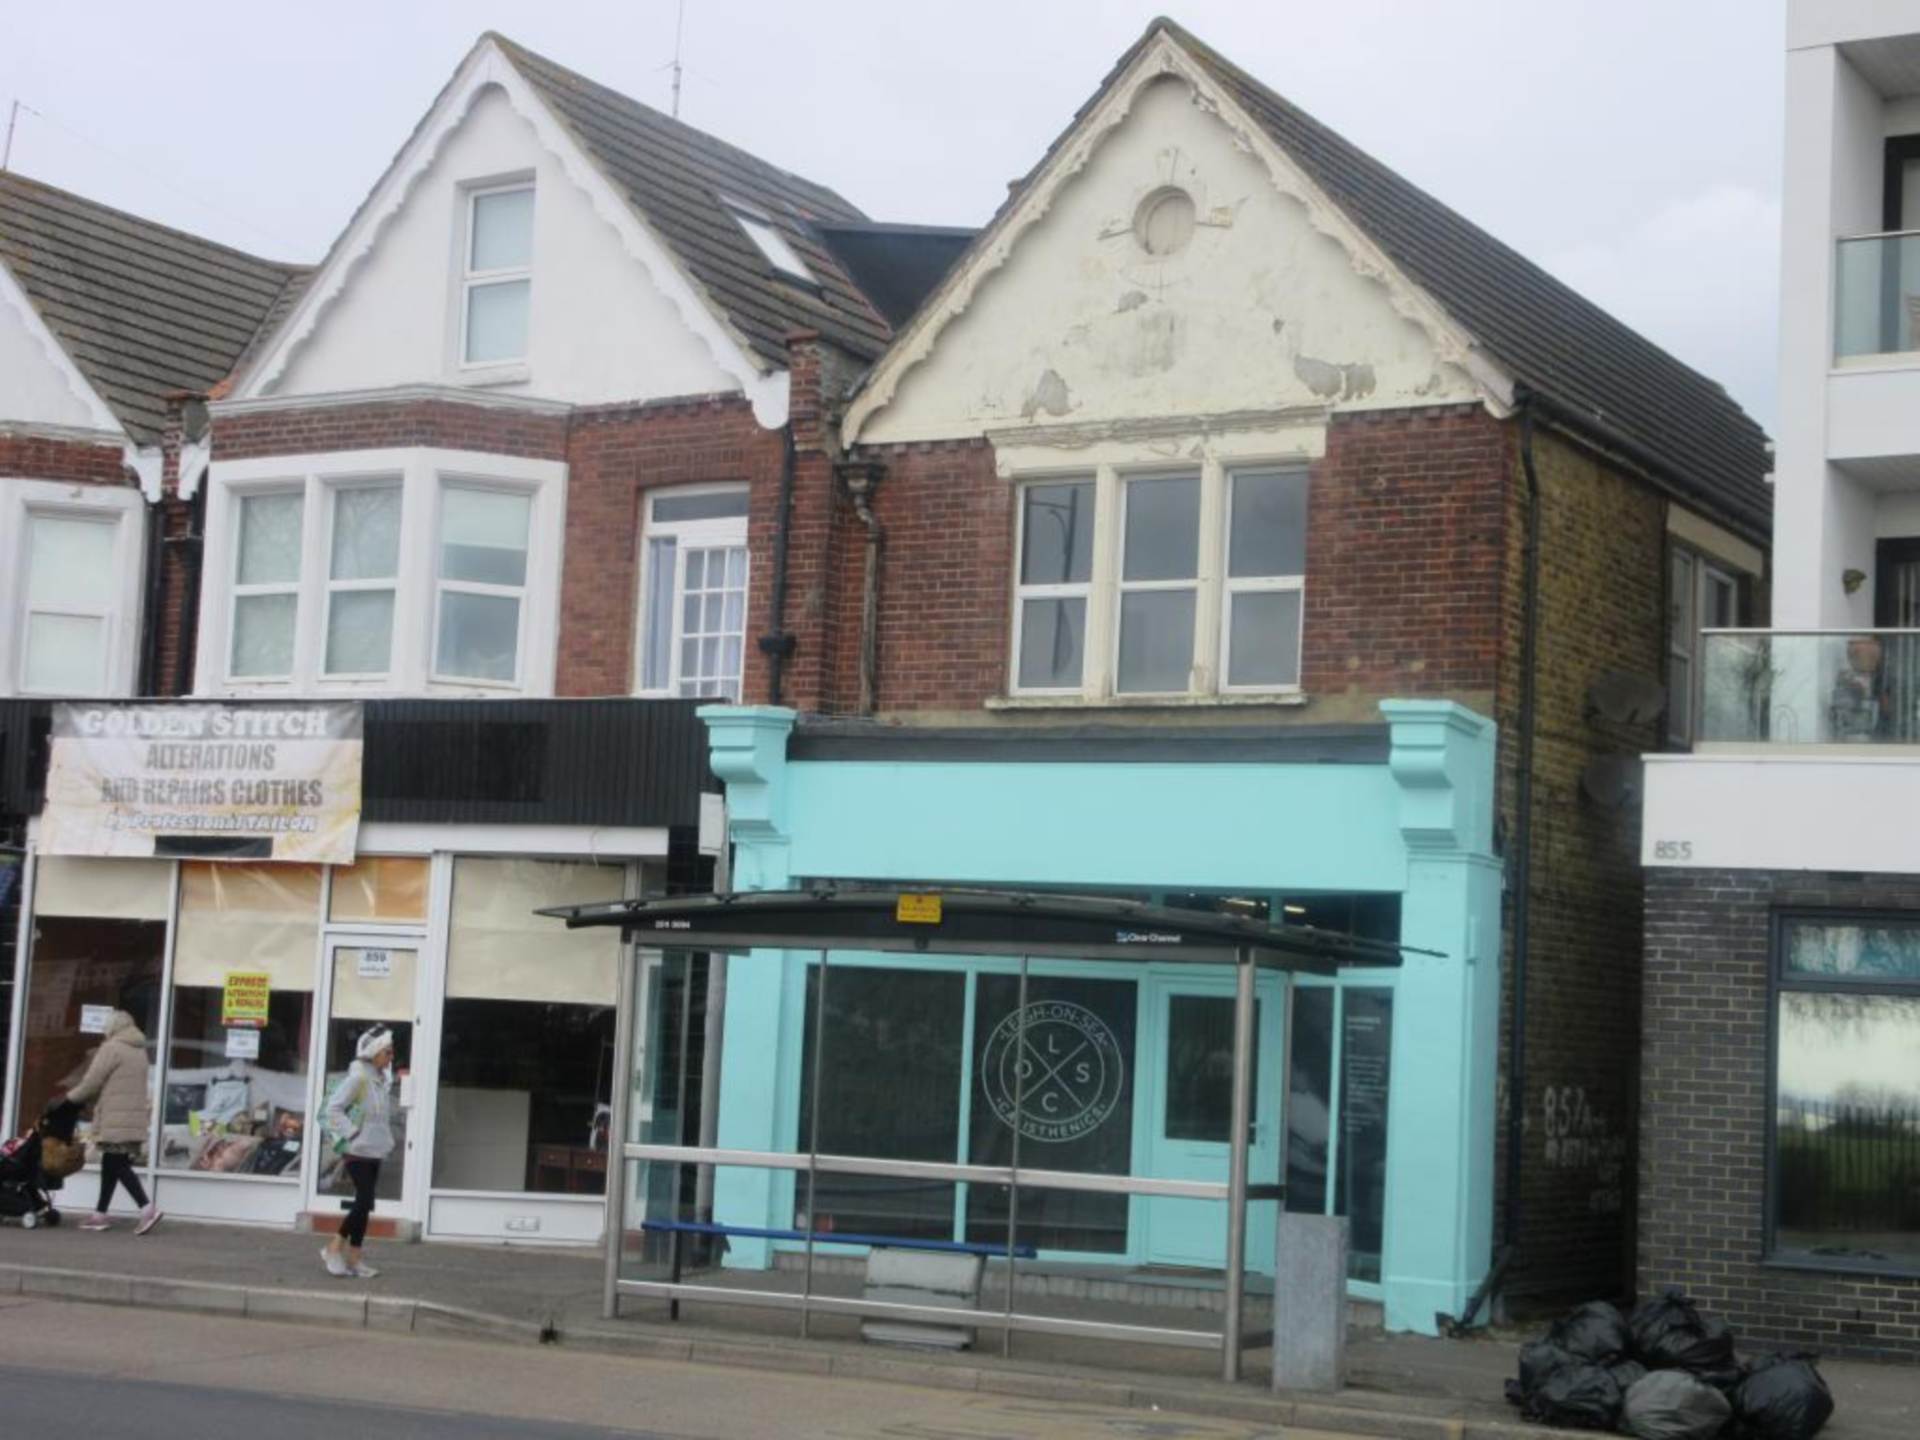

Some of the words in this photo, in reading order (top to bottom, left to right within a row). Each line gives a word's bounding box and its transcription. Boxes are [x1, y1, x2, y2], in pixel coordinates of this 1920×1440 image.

[84, 710, 206, 737] GOLDEN
[212, 710, 330, 737] STITCH
[146, 743, 276, 771] ALTERATIONS
[102, 776, 139, 804] AND
[143, 777, 227, 806] REPAIRS
[231, 778, 323, 808] CLOTHES
[1654, 840, 1692, 860] 855
